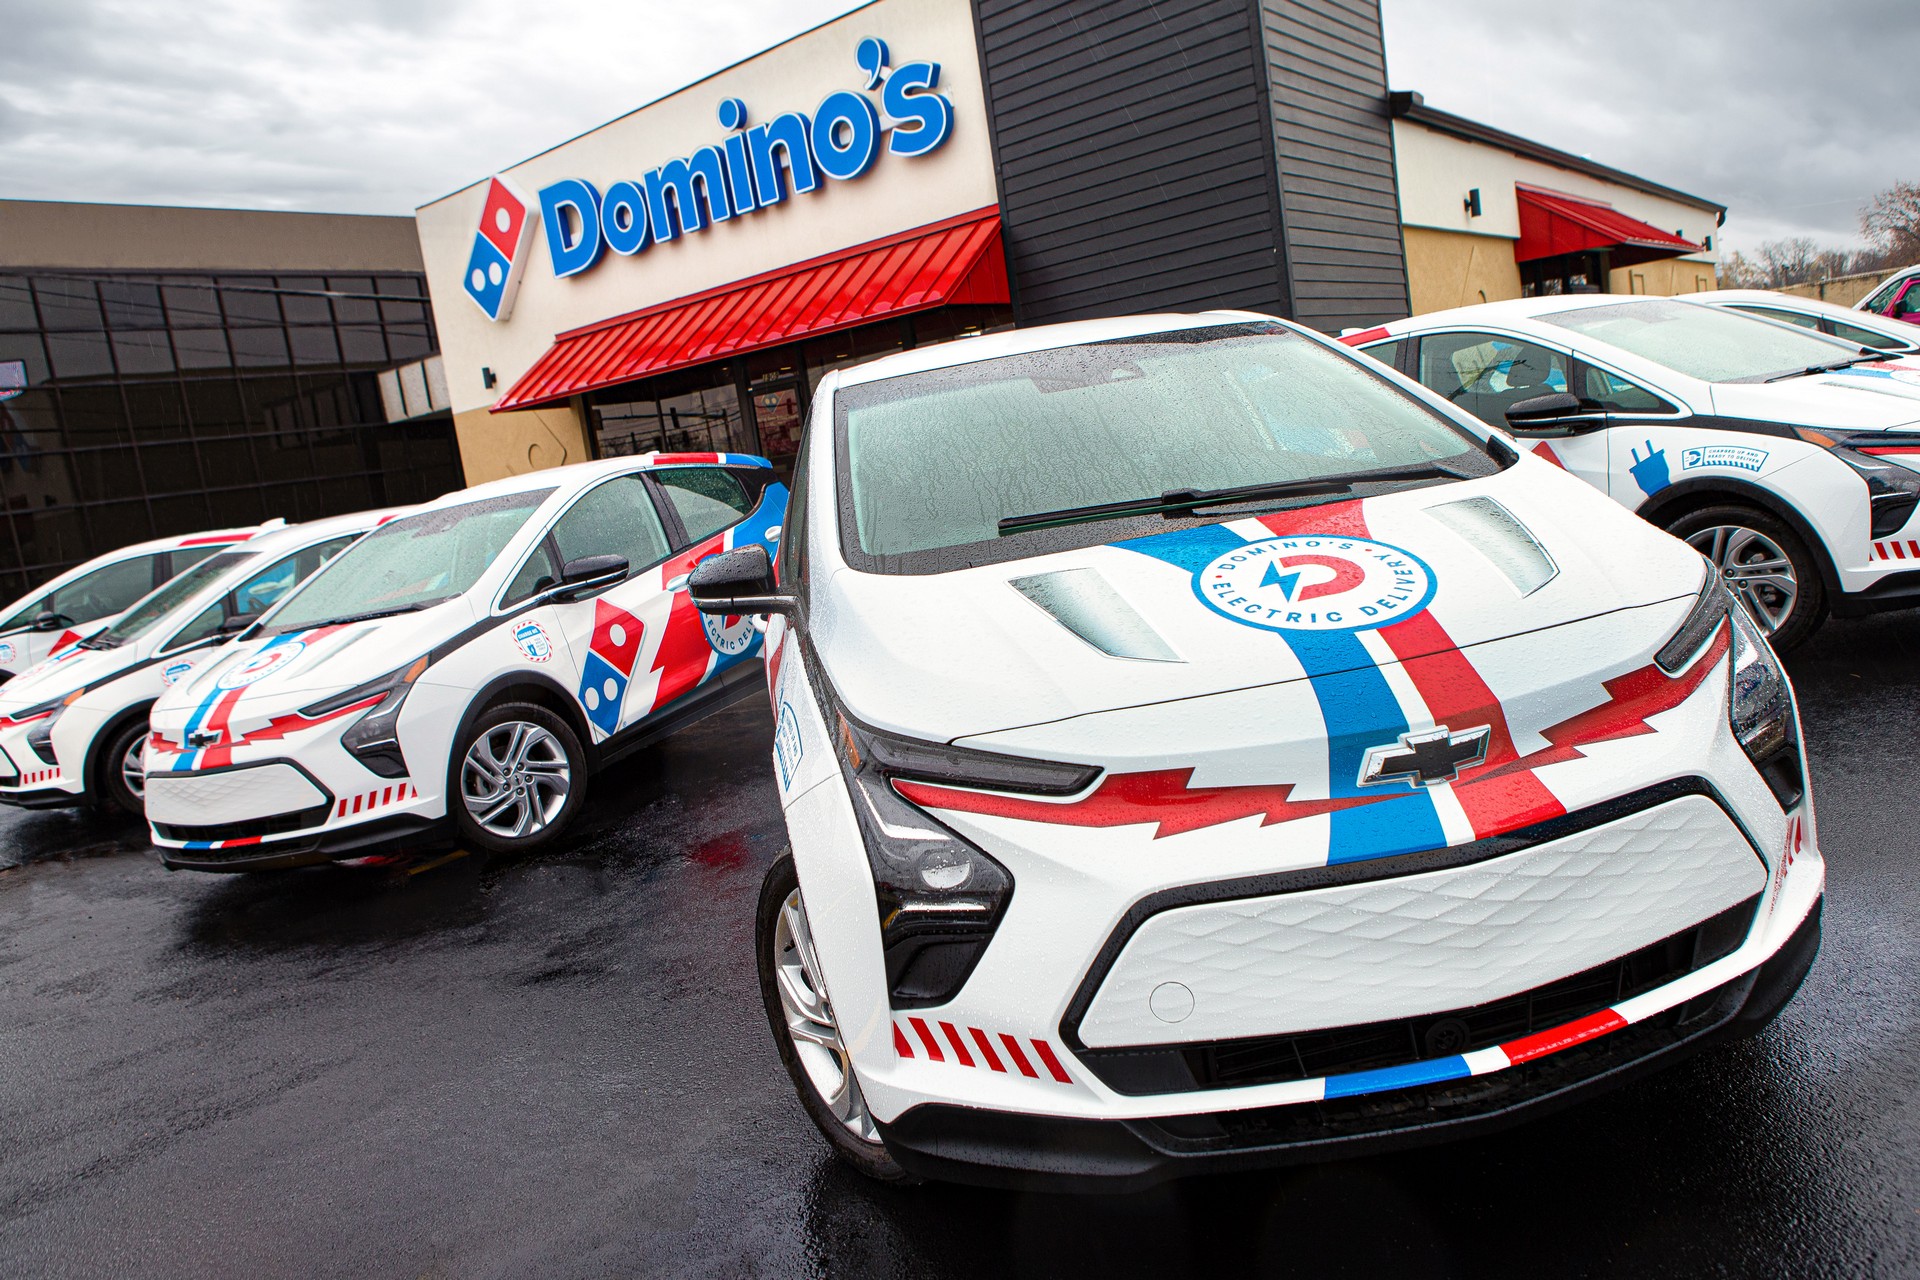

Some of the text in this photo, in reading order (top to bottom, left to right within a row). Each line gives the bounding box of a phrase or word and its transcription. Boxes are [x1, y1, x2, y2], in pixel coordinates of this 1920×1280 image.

[538, 36, 955, 279] Domino's
[1217, 541, 1354, 571] DOMINO'S
[1212, 553, 1416, 623] ELECTRIC DELIVERY
[705, 614, 735, 650] ECTRIC
